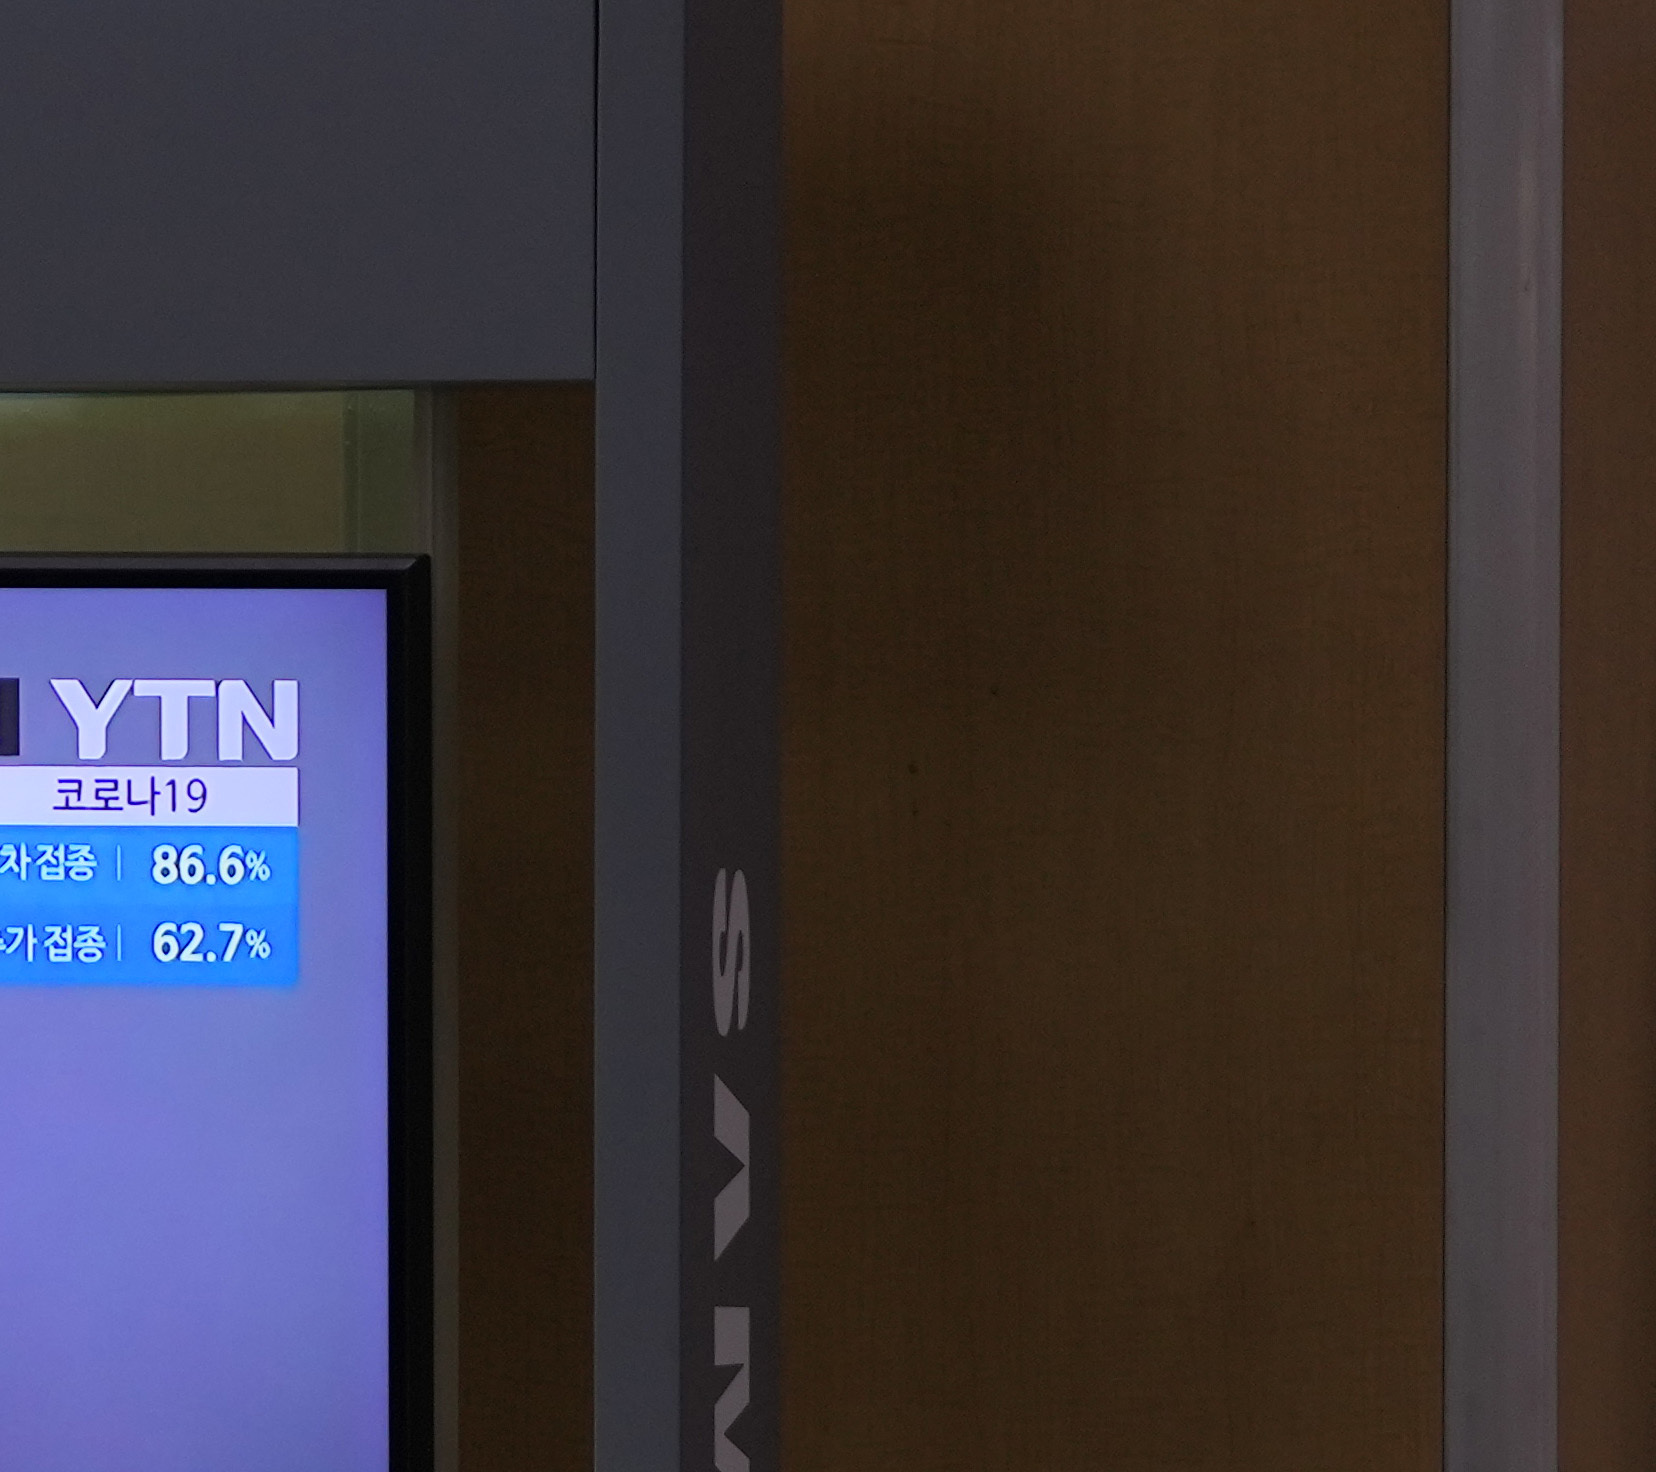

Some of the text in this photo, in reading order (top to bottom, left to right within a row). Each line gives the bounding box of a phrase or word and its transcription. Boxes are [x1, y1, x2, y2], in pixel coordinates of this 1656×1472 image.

[50, 679, 299, 761] YTN
[52, 777, 208, 817] 코로나19
[152, 845, 272, 885] 86.6%
[43, 924, 107, 963] 접종
[152, 922, 272, 962] 62.7%
